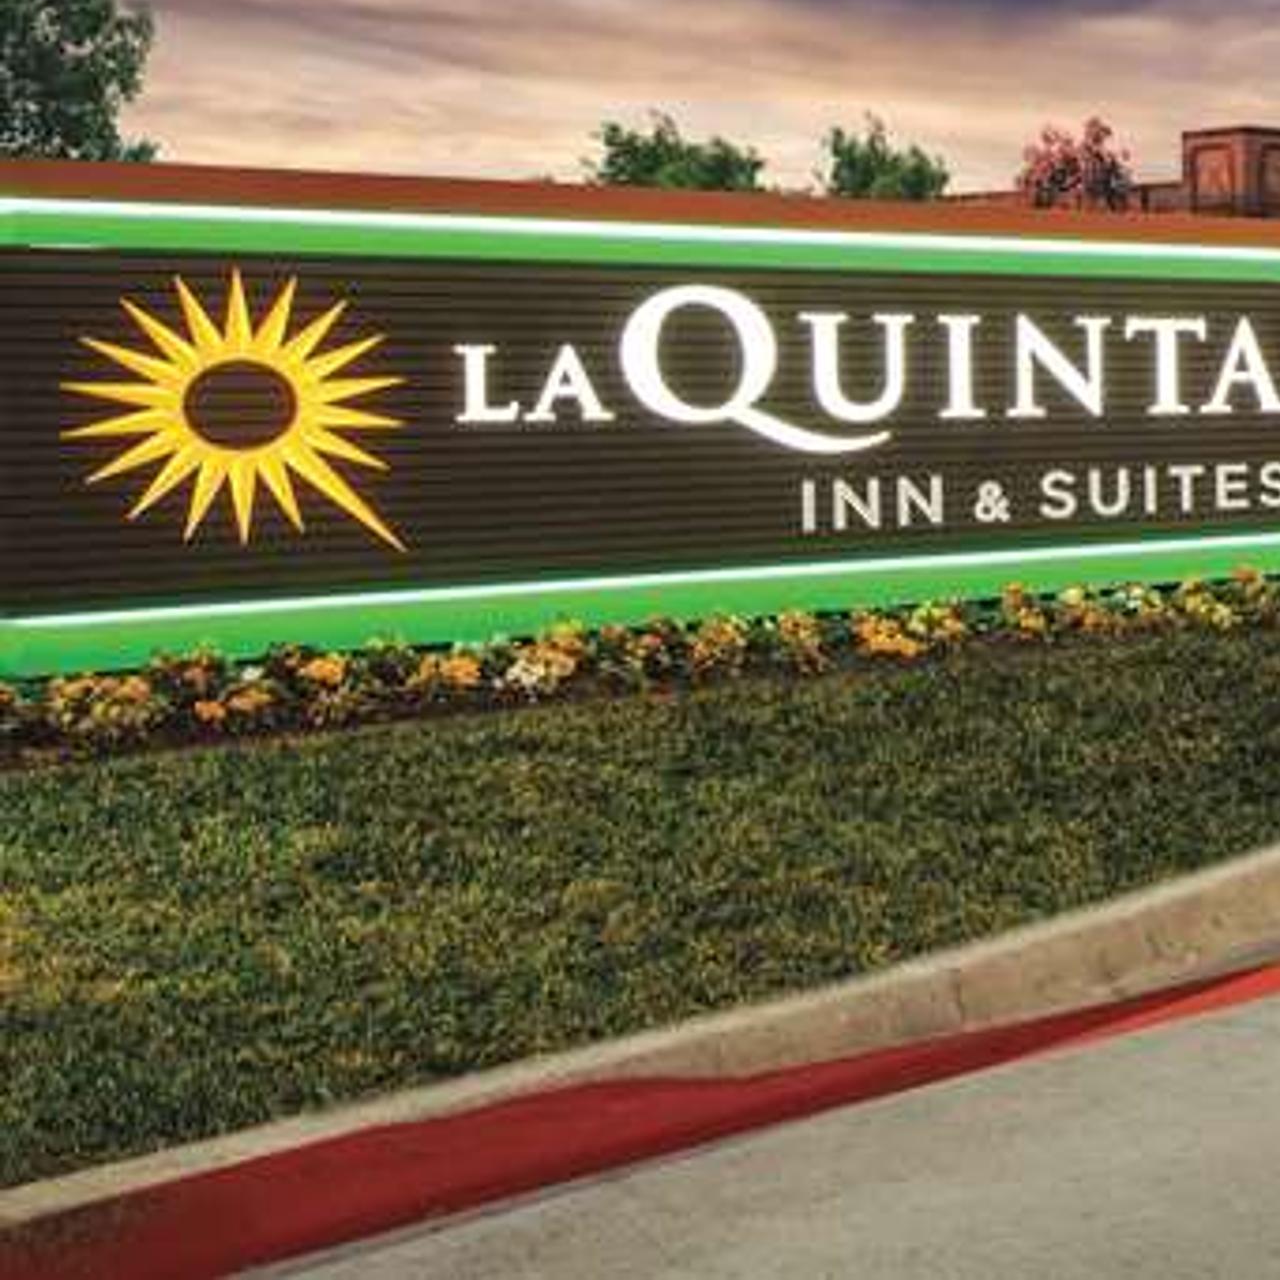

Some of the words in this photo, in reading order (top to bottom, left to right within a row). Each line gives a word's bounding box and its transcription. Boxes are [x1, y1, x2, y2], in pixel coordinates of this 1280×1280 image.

[453, 343, 613, 424] LA
[801, 474, 944, 533] INN
[973, 480, 1011, 523] &
